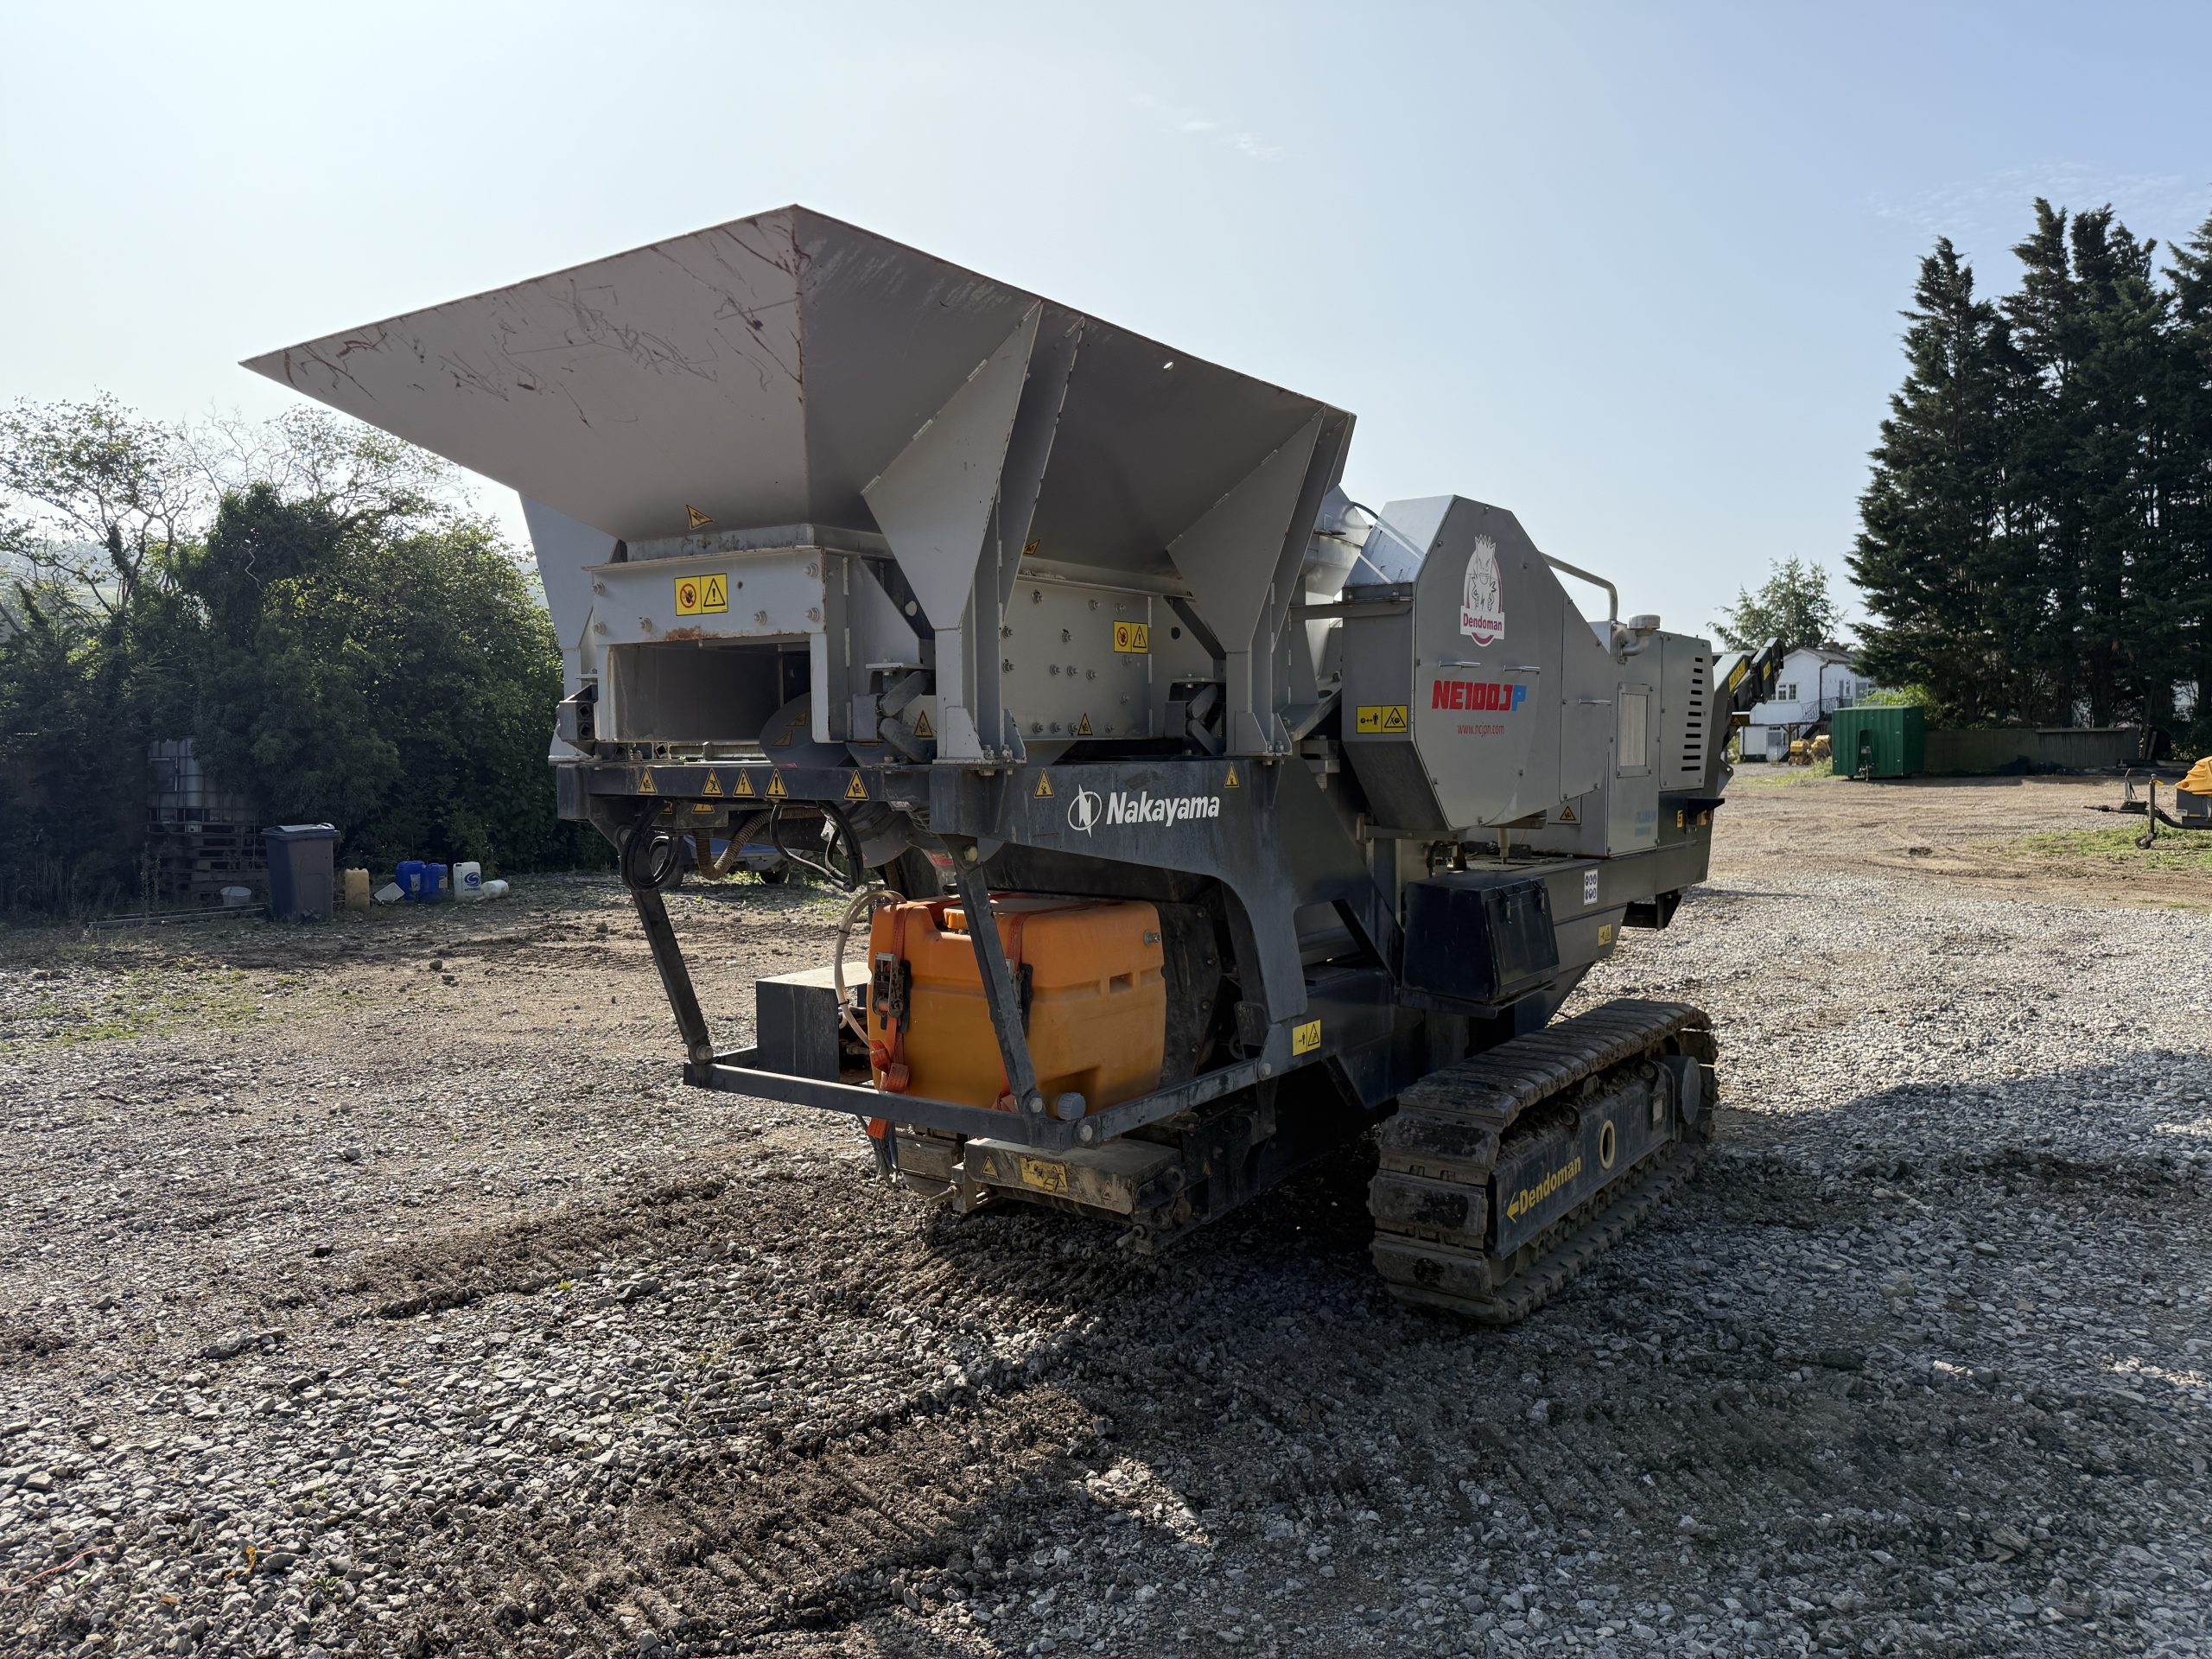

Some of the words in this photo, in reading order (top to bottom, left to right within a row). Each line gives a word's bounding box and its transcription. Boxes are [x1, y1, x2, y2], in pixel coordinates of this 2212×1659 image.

[1463, 613, 1502, 632] Dendoman
[1432, 679, 1527, 711] NE100JP
[1106, 791, 1220, 827] Nakayama
[1520, 1156, 1581, 1215] Dendoman
